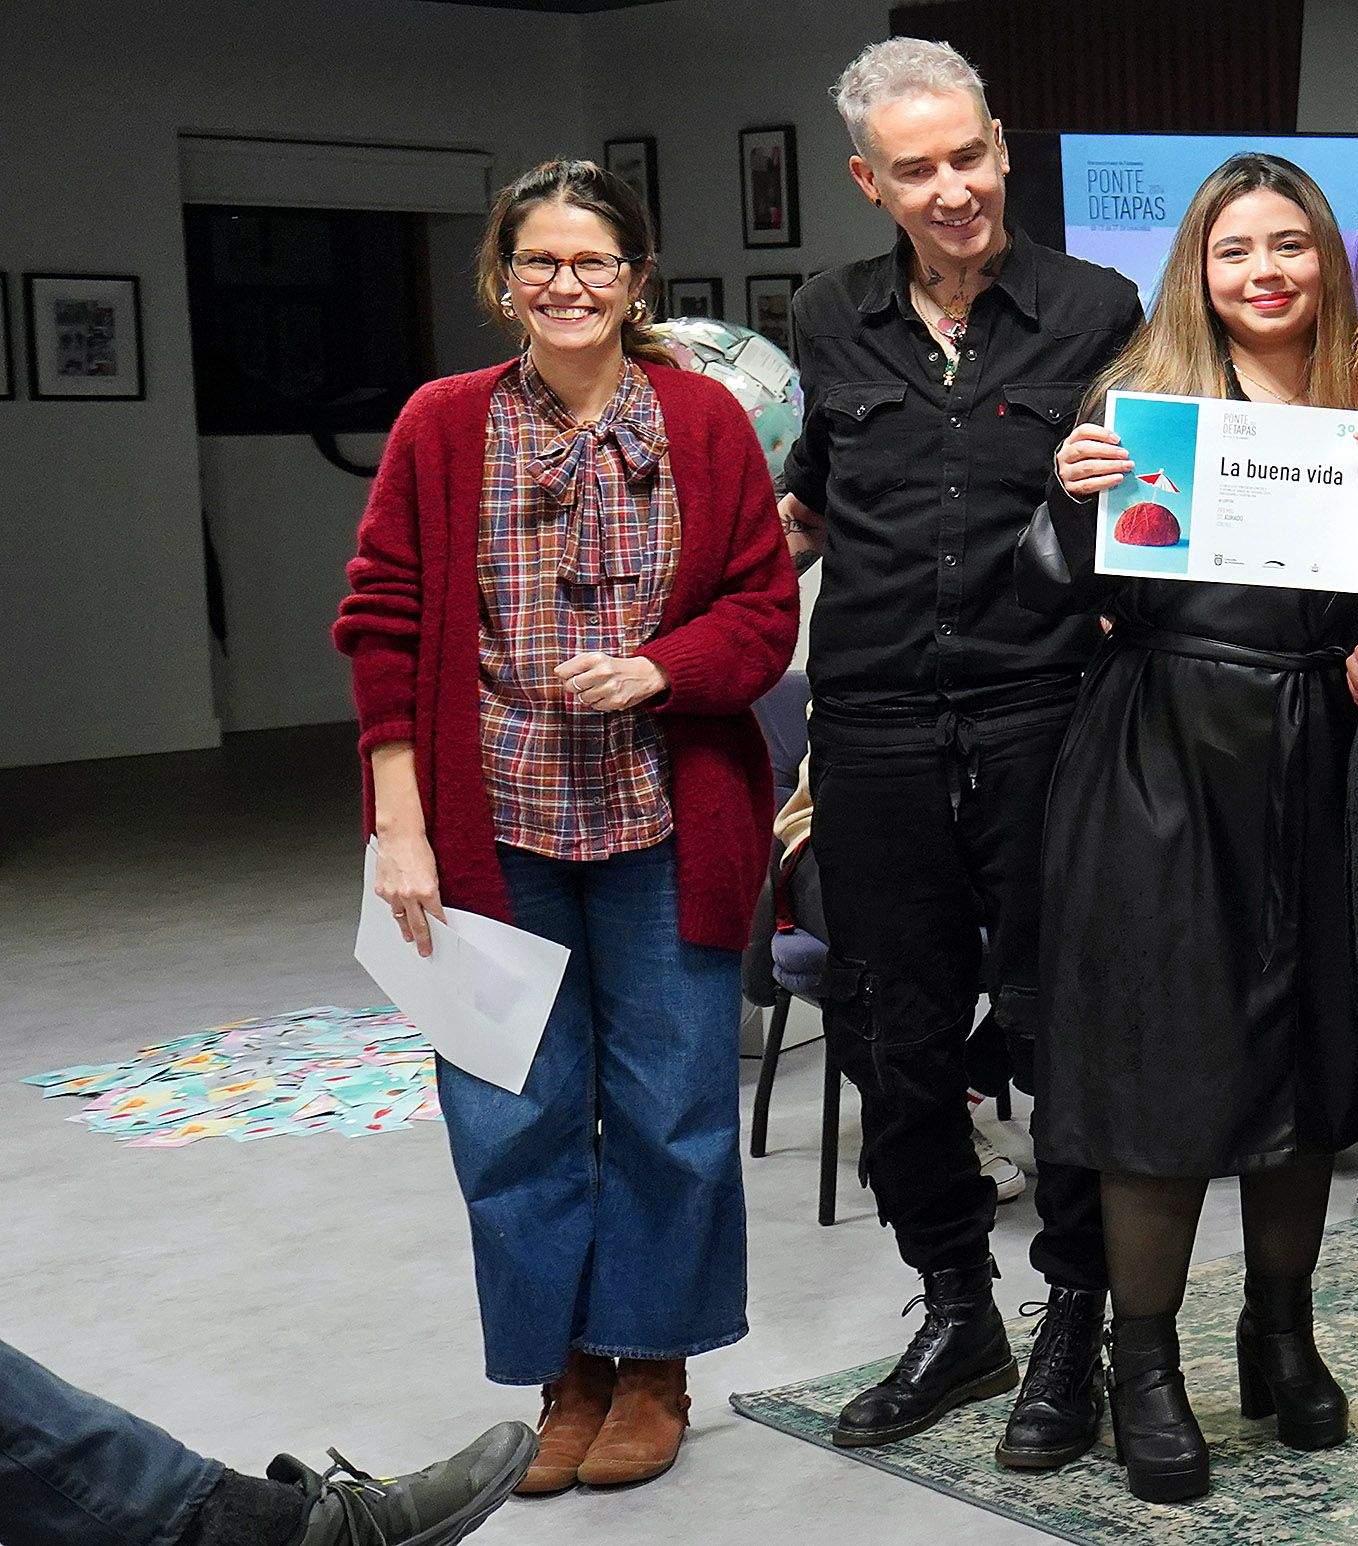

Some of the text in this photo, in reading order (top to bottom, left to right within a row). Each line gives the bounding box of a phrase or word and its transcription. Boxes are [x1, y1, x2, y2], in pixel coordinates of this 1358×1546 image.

[1087, 168, 1144, 193] PONTE
[1088, 195, 1166, 220] DETAPAS
[1220, 457, 1343, 486] La buena vida
